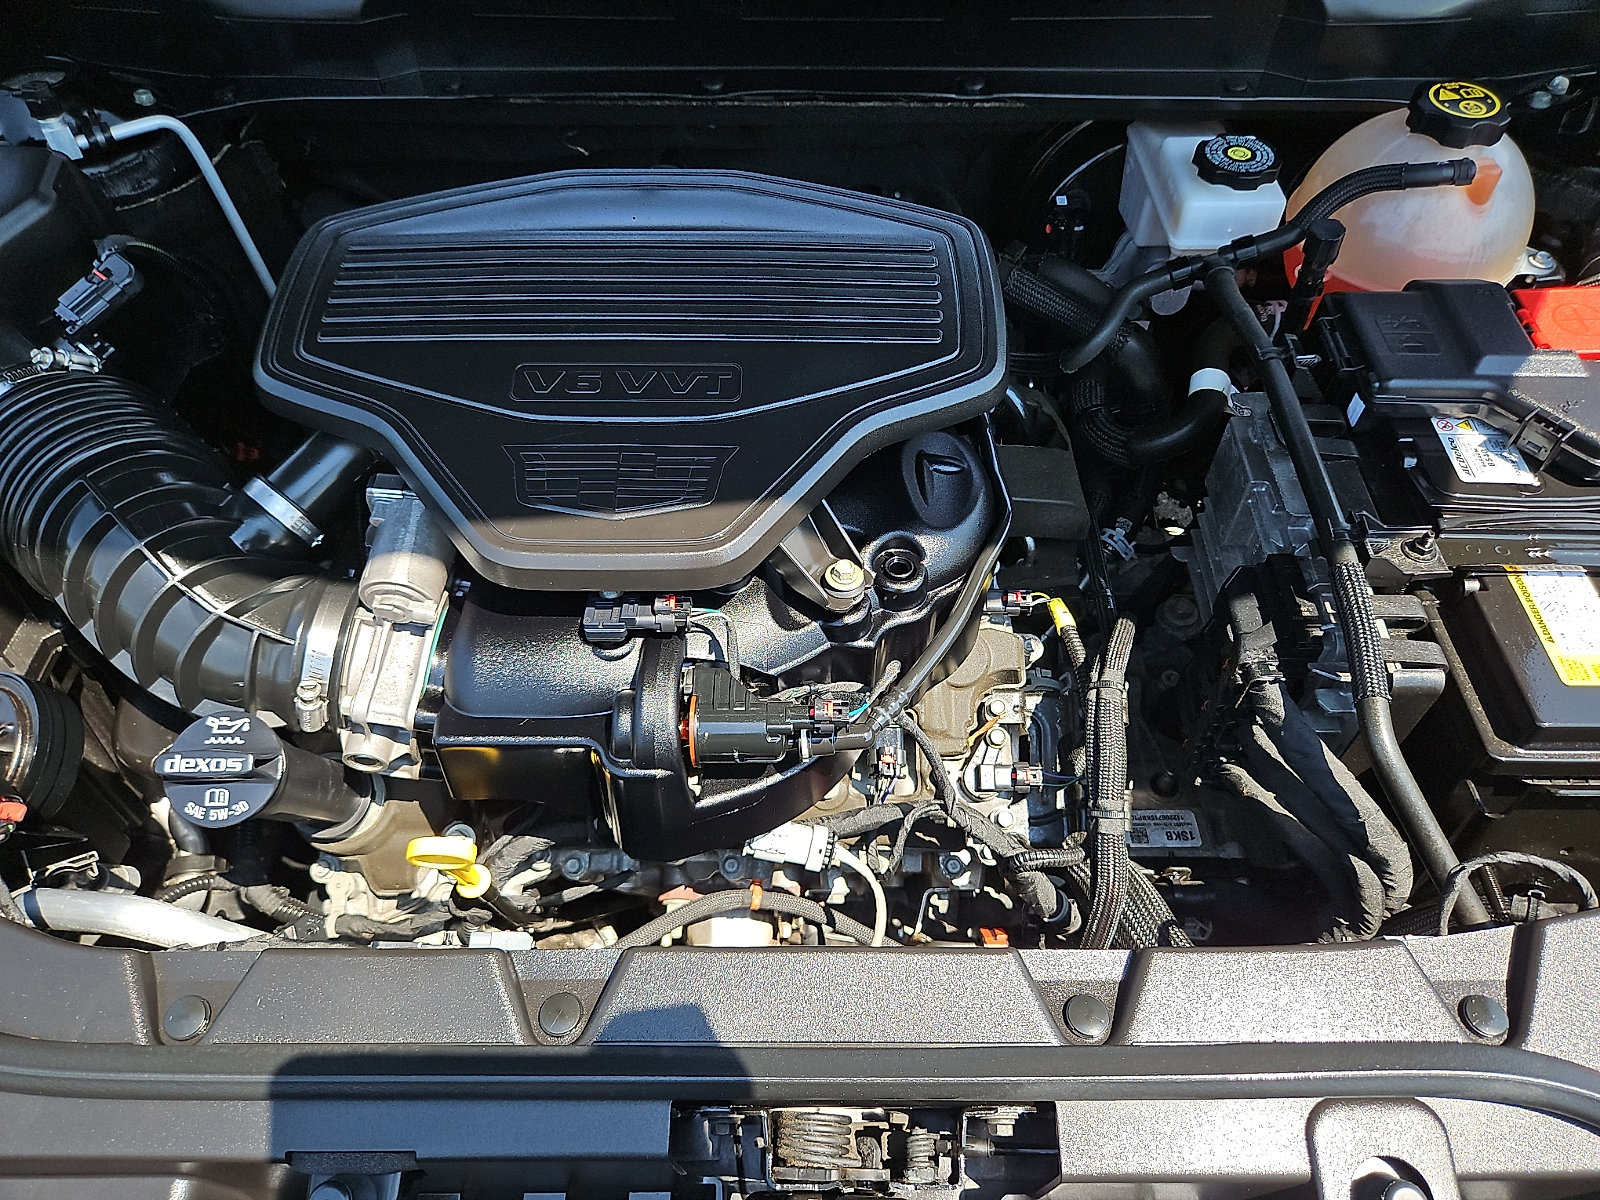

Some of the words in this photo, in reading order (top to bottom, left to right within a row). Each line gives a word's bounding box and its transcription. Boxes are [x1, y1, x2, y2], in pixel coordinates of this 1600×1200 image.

[523, 370, 602, 394] V6
[615, 370, 733, 395] VVT
[163, 754, 247, 774] dexos
[184, 801, 207, 820] SAE
[208, 800, 250, 821] 5W-30
[1165, 830, 1196, 841] 1SKB
